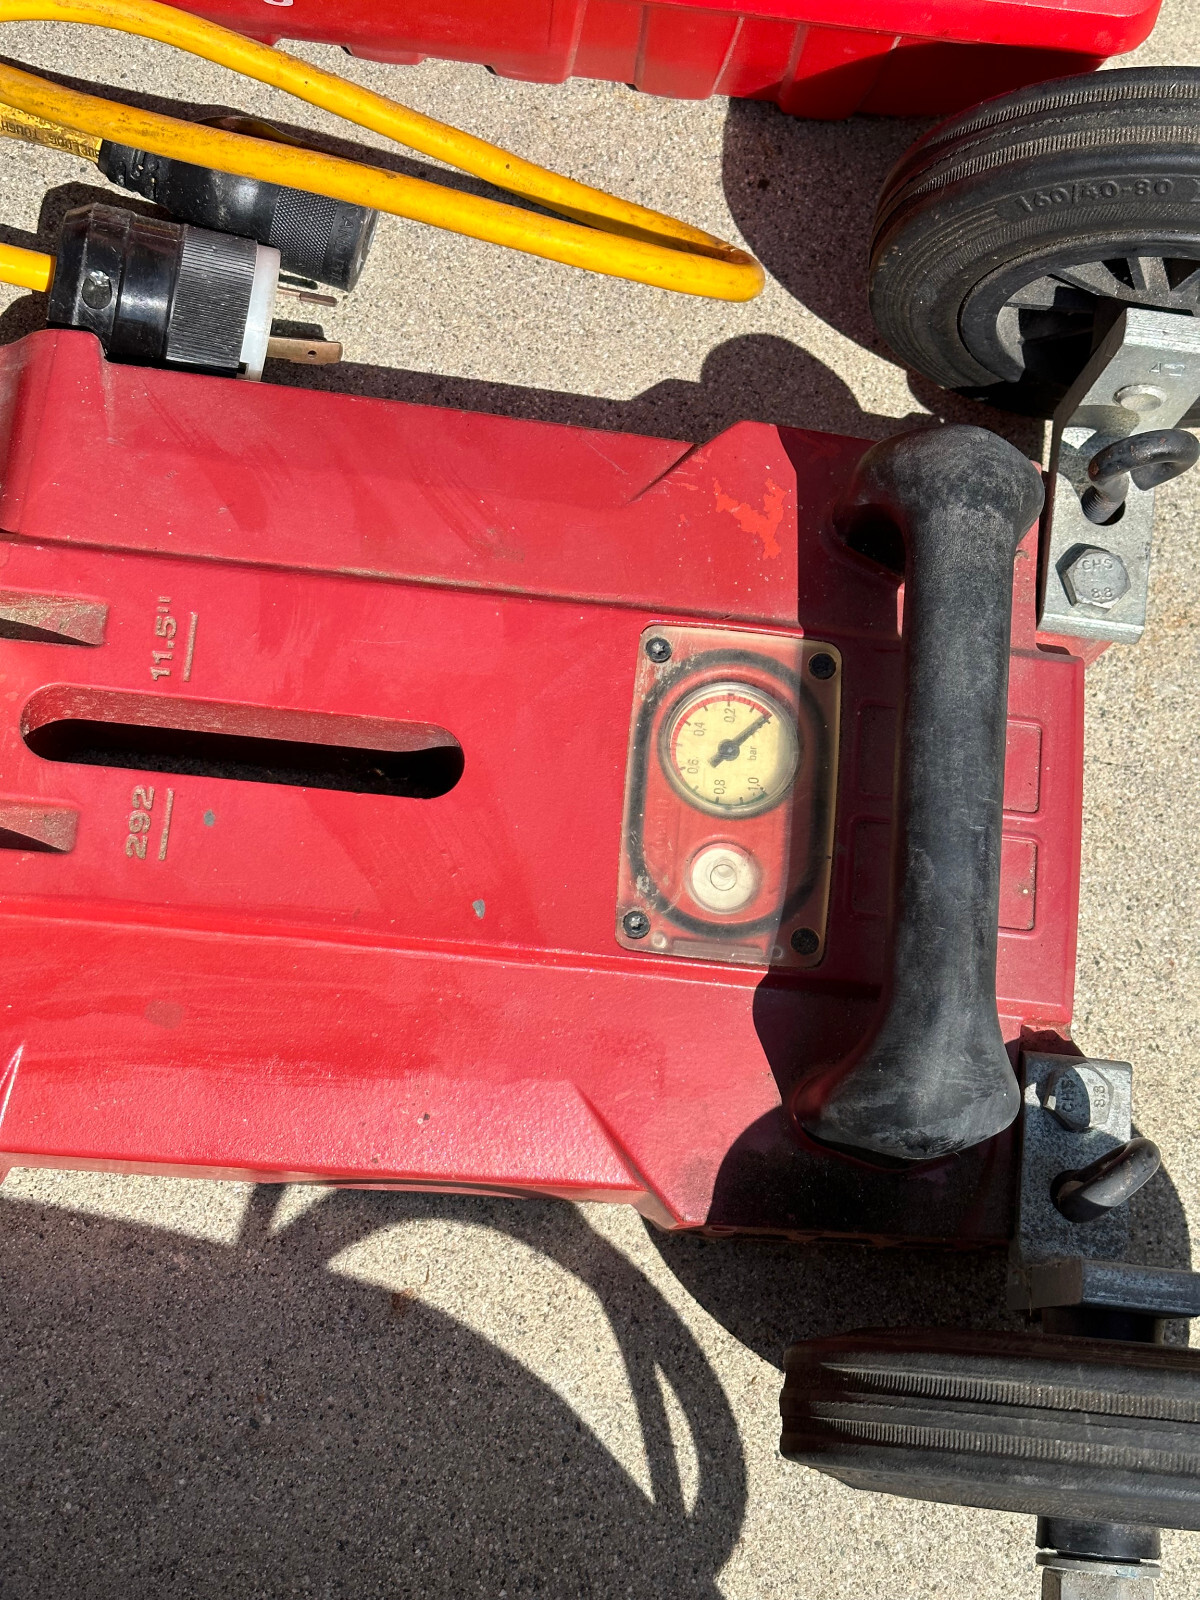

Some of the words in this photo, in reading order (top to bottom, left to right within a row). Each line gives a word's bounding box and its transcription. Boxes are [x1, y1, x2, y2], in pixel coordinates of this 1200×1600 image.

[1, 120, 39, 140] TOUGH
[149, 595, 178, 682] 11.5"
[747, 745, 758, 761] bar
[125, 784, 155, 860] 292
